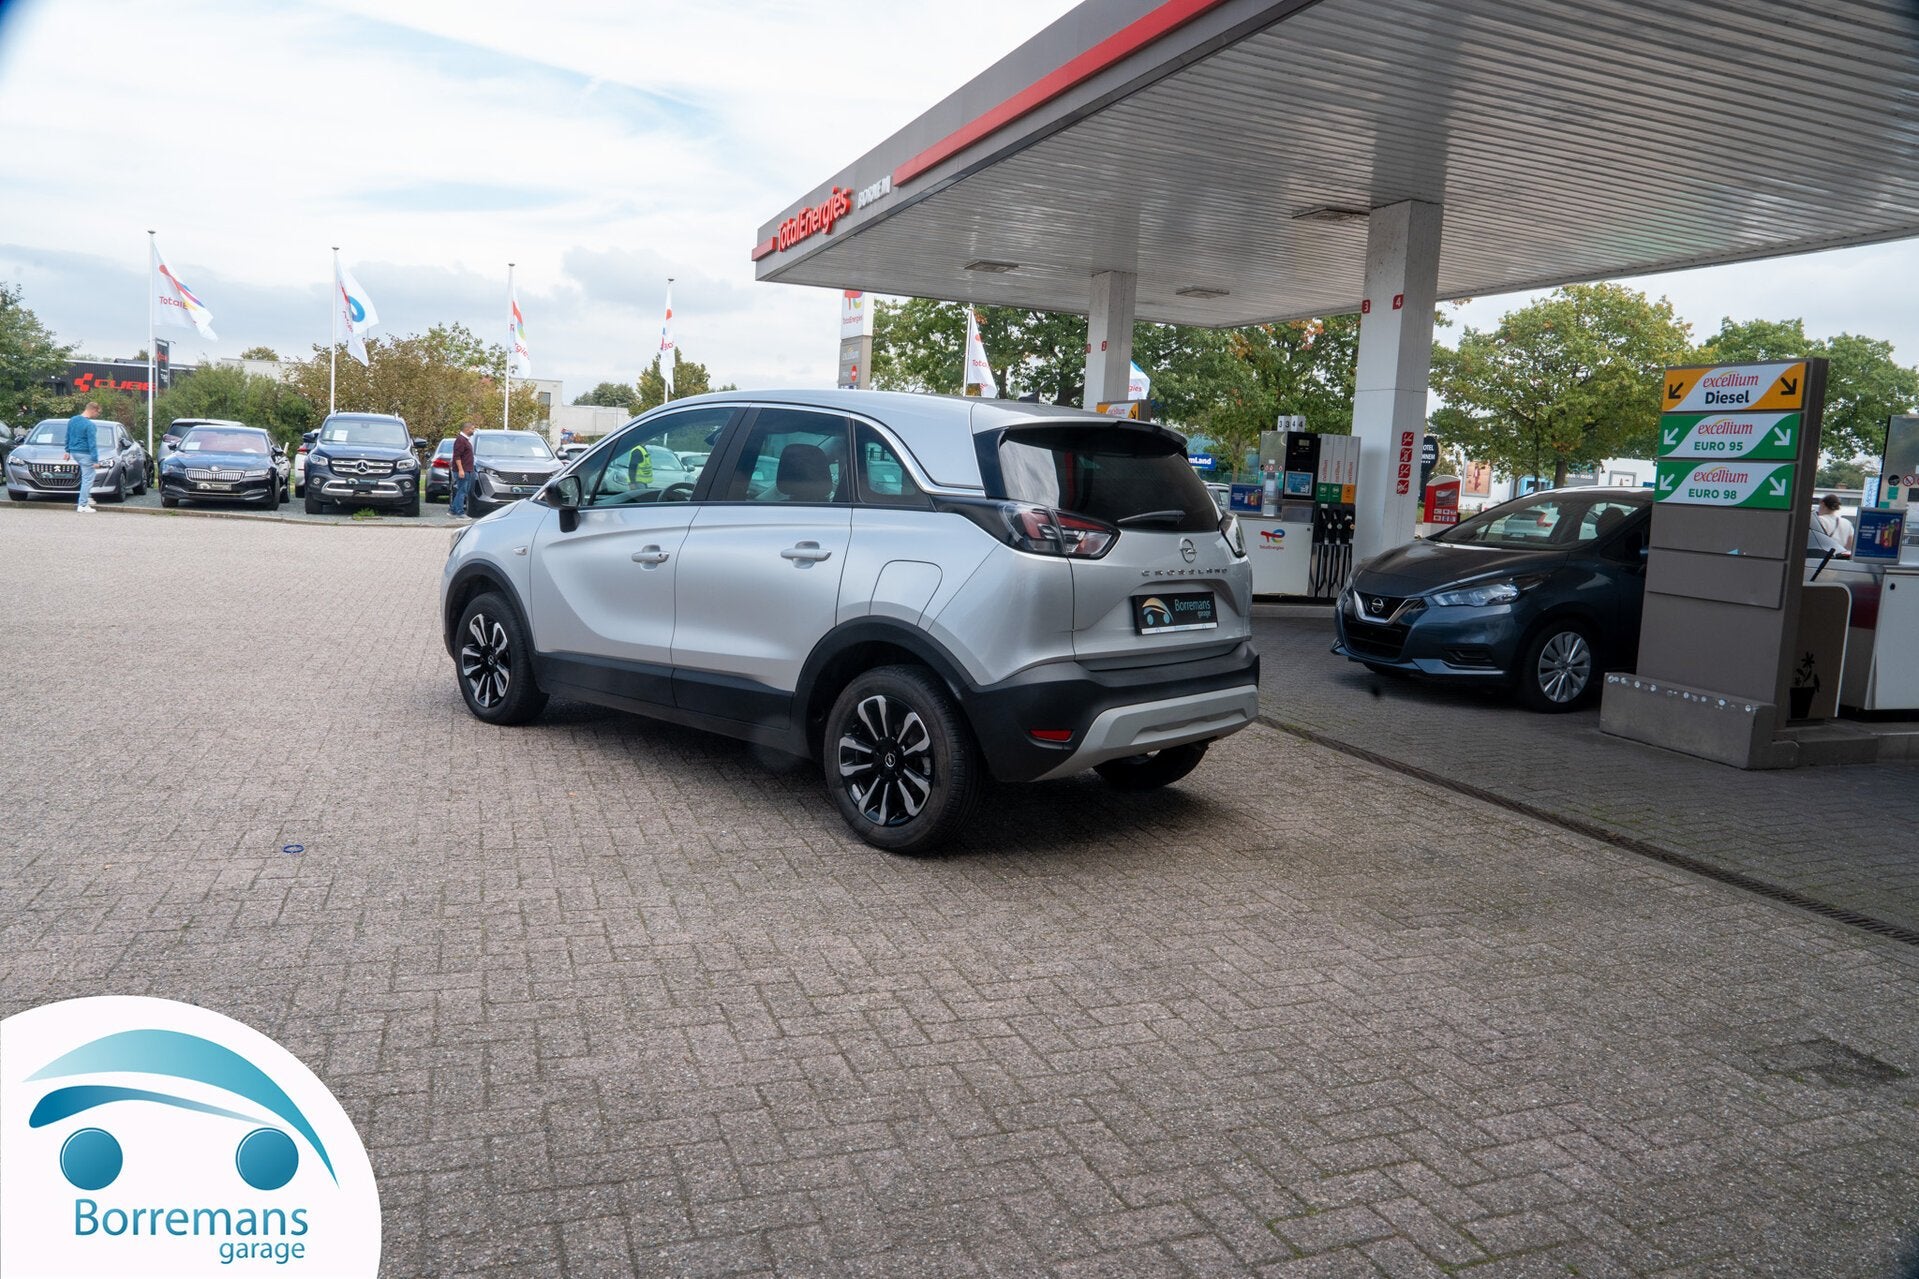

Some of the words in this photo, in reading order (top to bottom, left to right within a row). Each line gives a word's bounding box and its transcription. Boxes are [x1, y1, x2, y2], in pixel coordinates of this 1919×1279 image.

[778, 185, 853, 252] TotalEnergies
[1703, 372, 1759, 388] excellium
[1705, 390, 1750, 405] Diesel
[1697, 418, 1753, 435] excellium
[1694, 441, 1726, 451] EURO
[1729, 441, 1743, 451] 95
[1693, 468, 1748, 484] excellium
[1688, 488, 1720, 499] EURO
[1723, 489, 1737, 500] 98
[1142, 568, 1228, 577] CROSSLAND
[1175, 599, 1211, 611] Borremans
